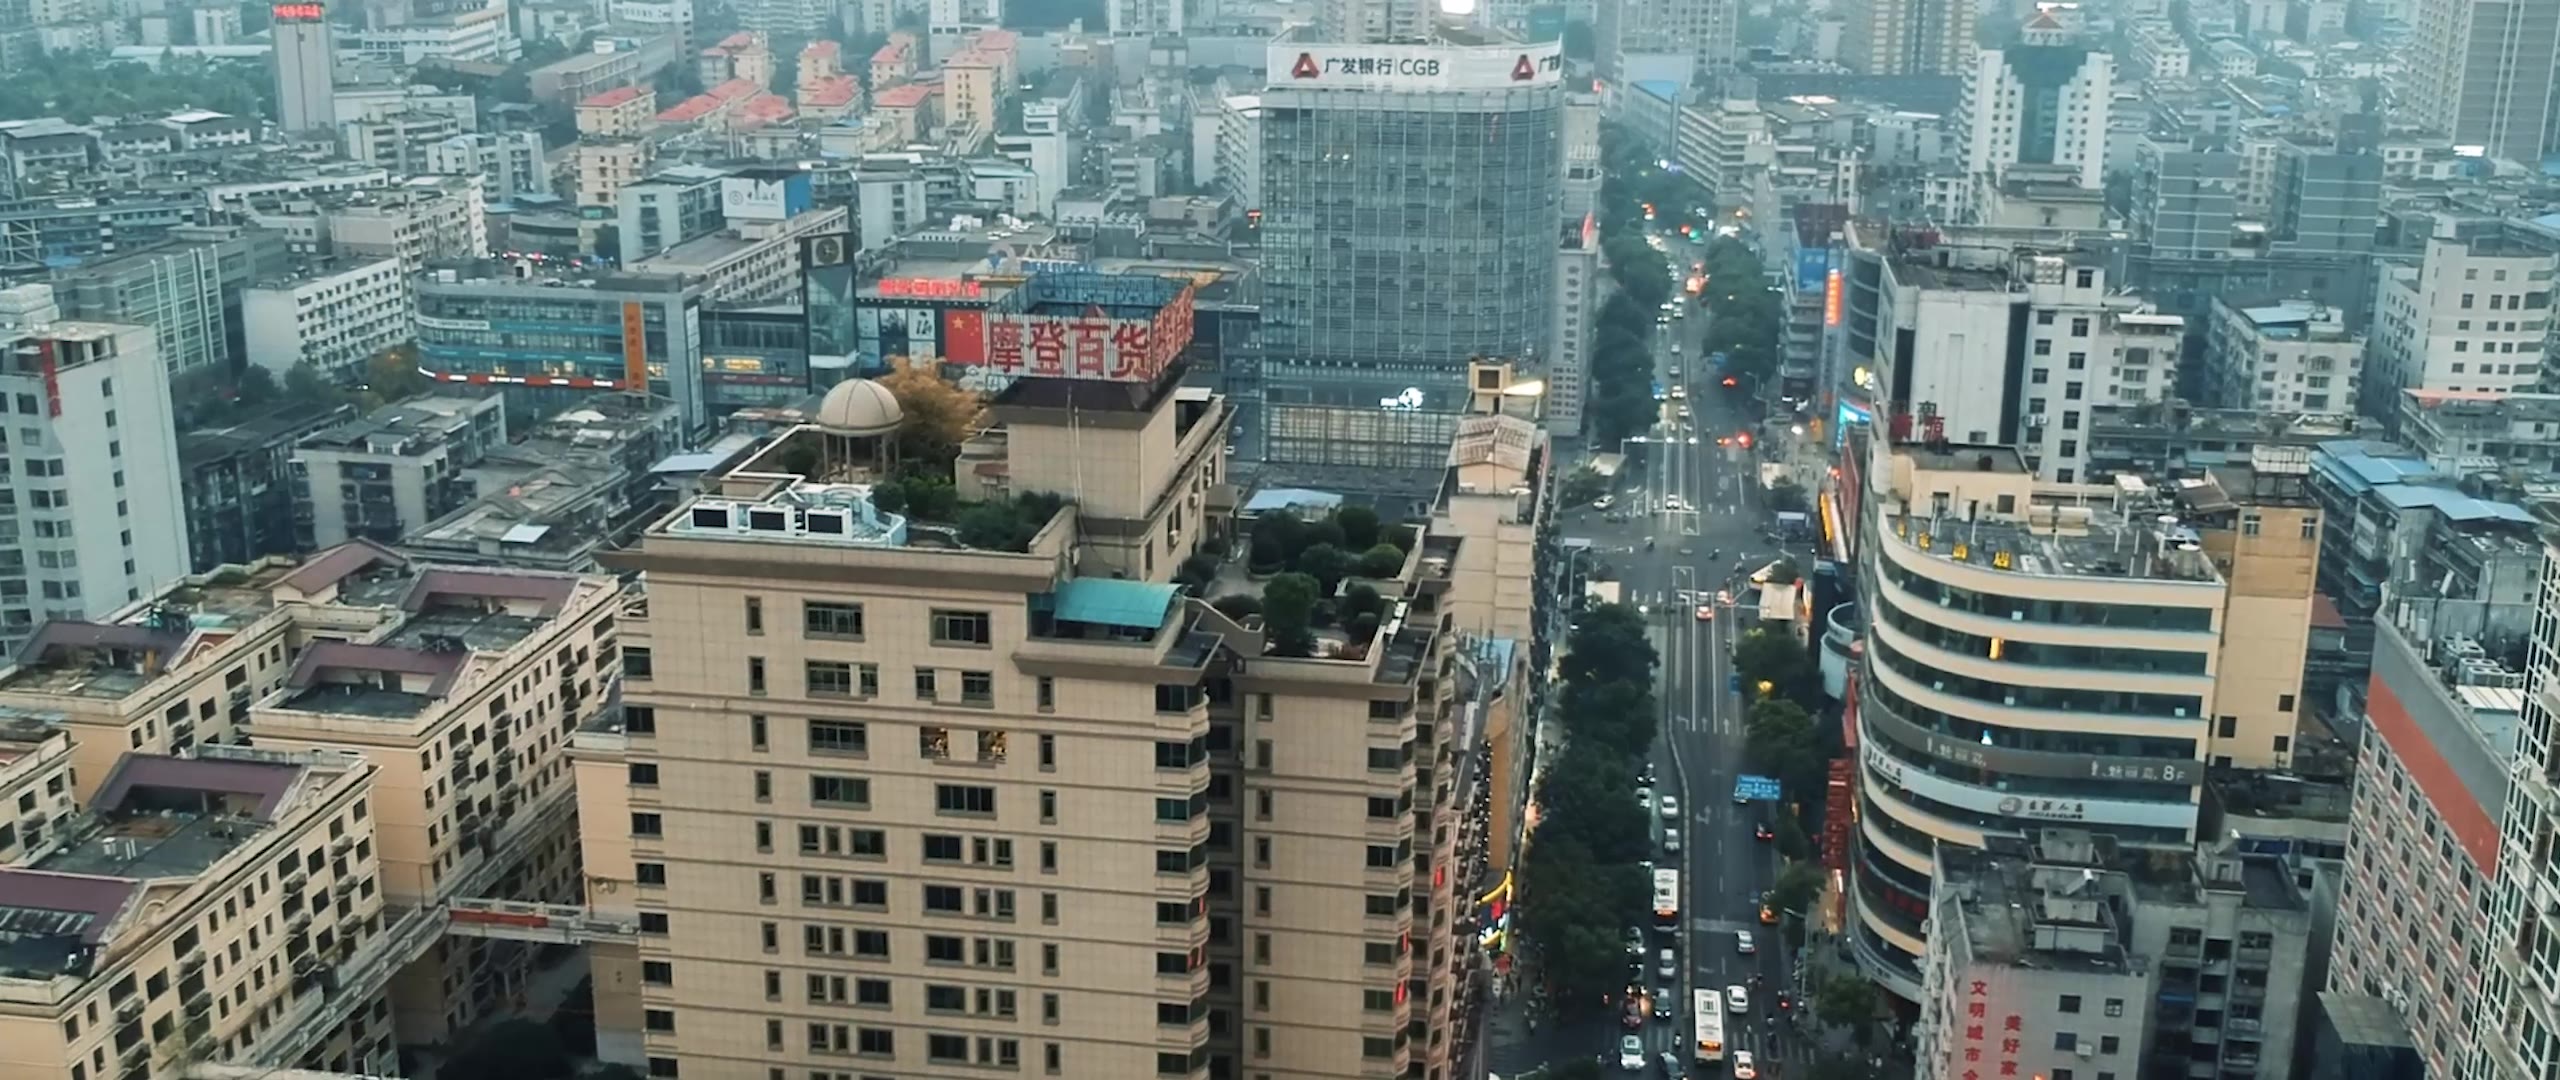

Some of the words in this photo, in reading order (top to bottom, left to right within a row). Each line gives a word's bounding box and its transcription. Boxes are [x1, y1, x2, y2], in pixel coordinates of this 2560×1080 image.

[1324, 58, 1393, 76] 广发银行
[1400, 58, 1440, 76] CGB
[990, 319, 1151, 383] 摩登百货
